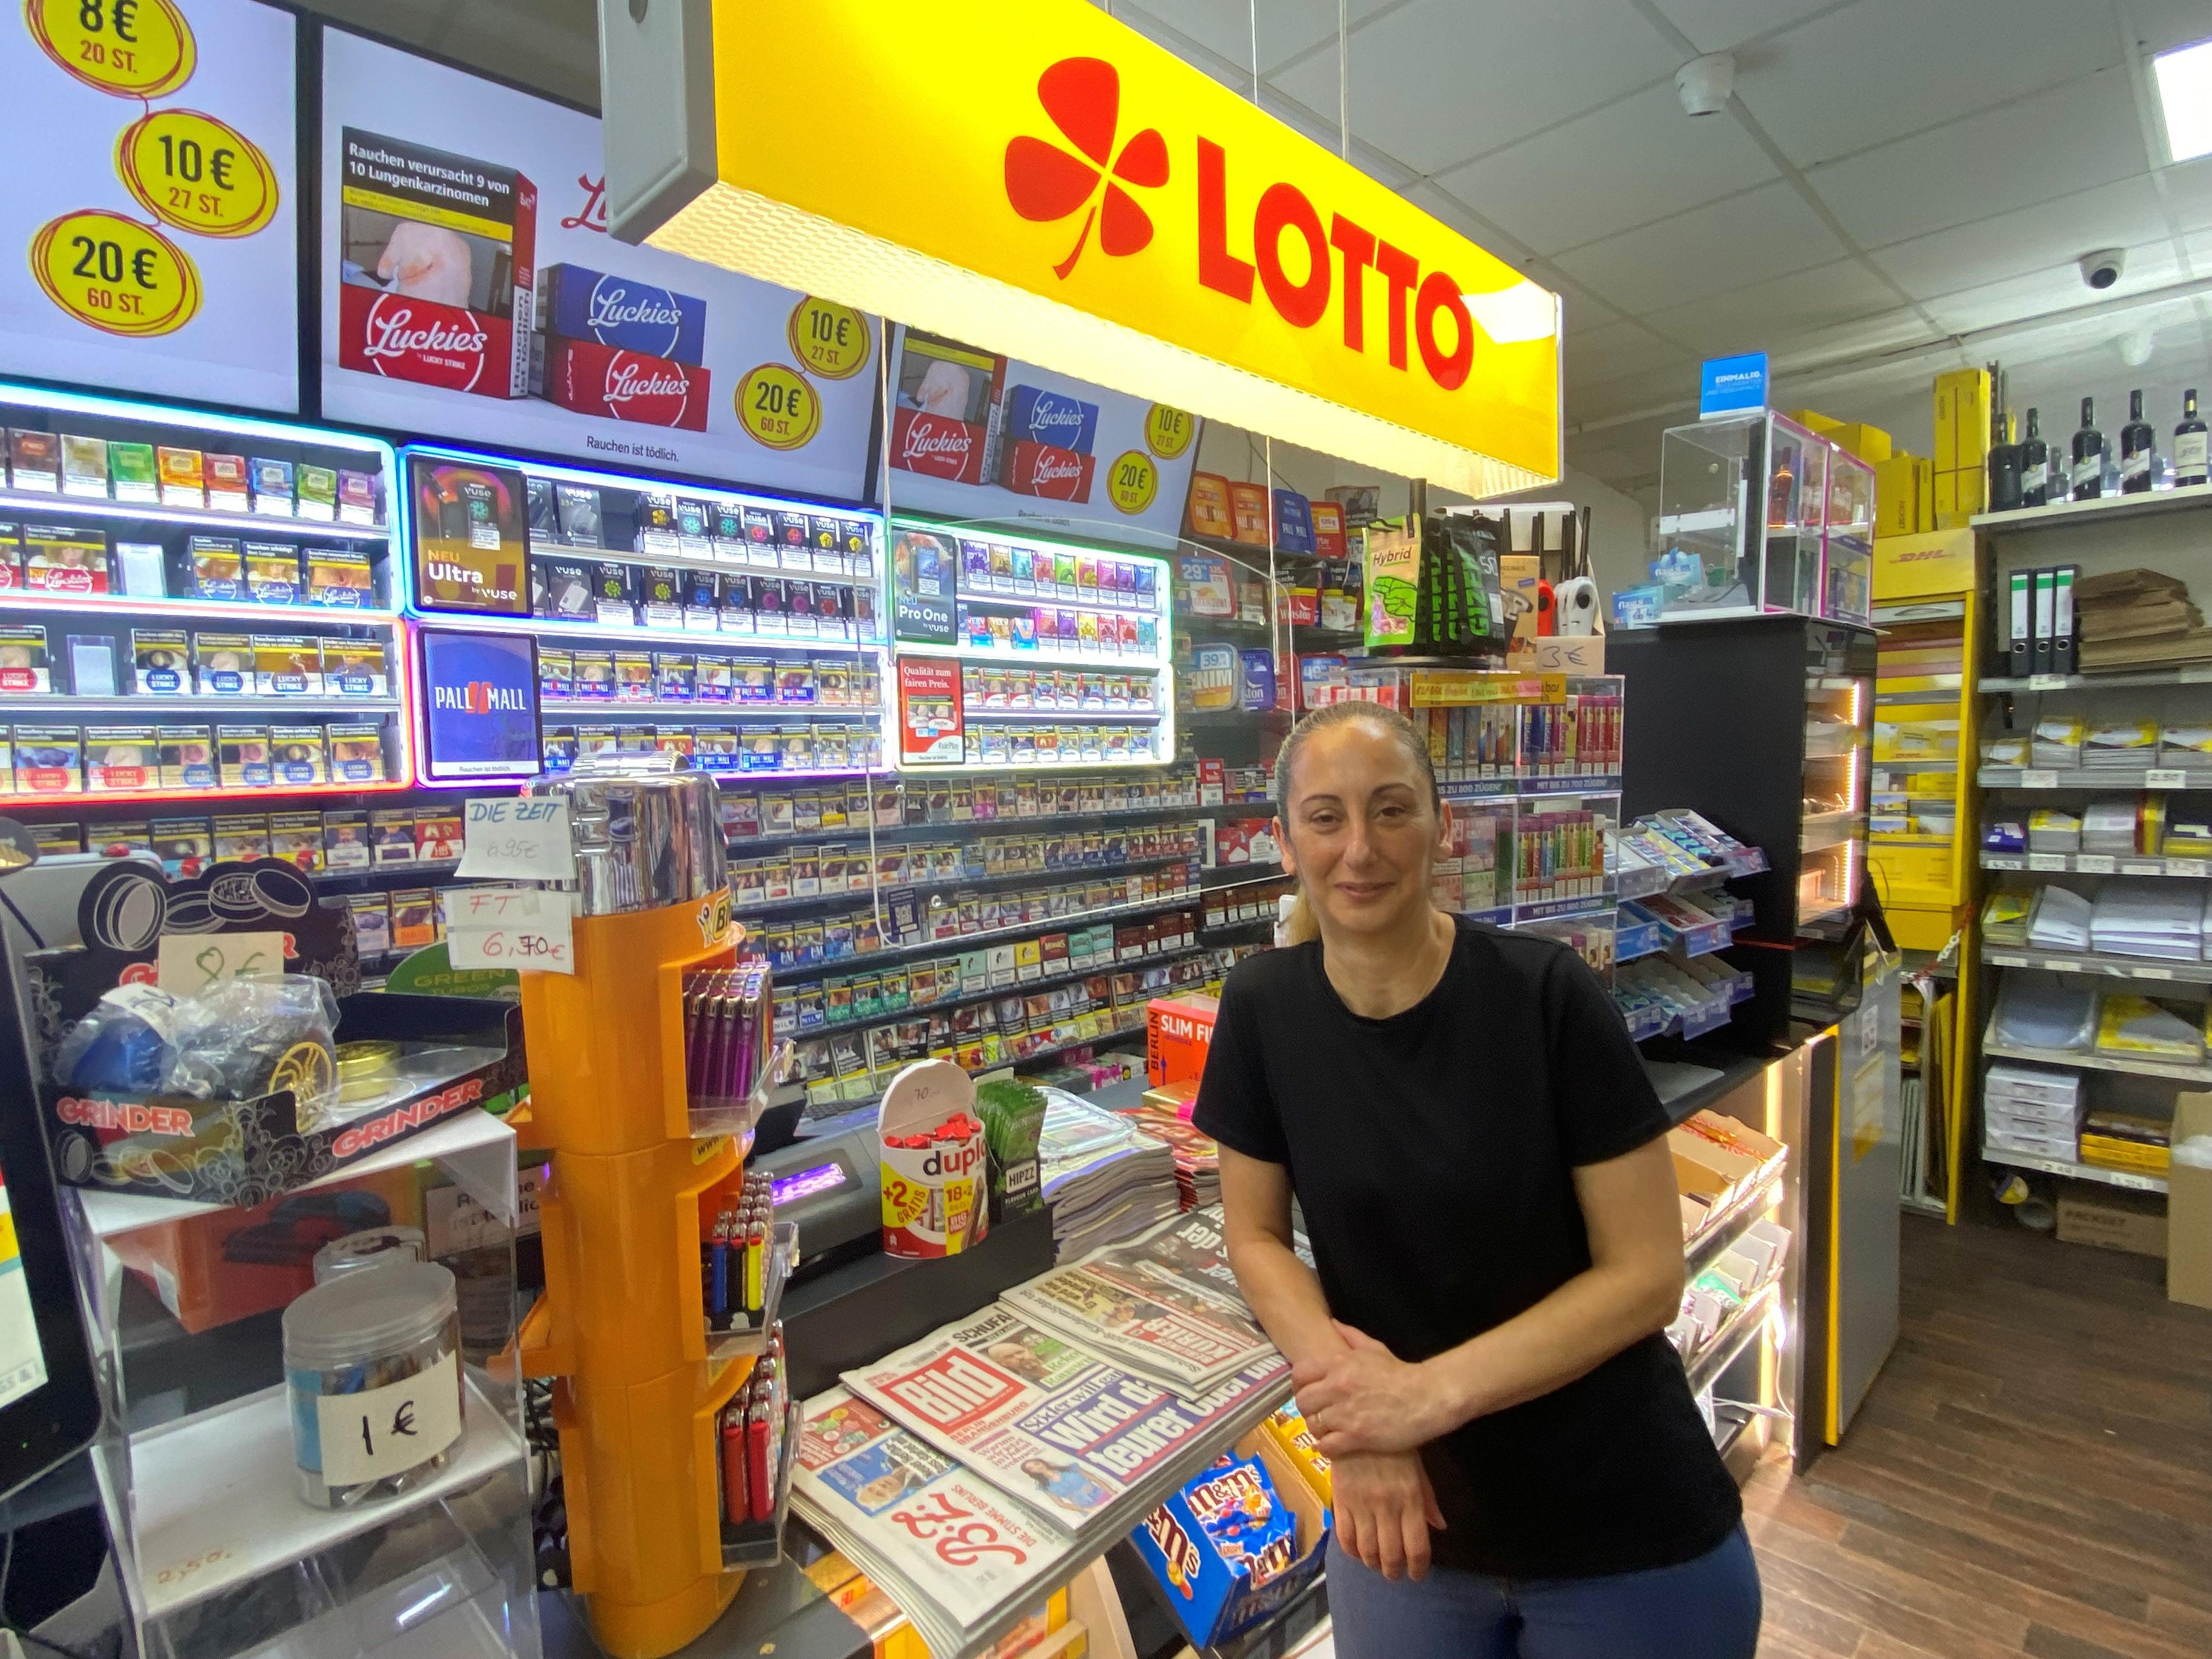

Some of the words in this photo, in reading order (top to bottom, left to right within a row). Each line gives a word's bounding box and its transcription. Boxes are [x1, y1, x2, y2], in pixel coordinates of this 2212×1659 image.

[80, 0, 103, 33] 8
[80, 40, 104, 65] 20
[112, 50, 138, 74] ST.
[159, 135, 201, 183] 10
[349, 142, 404, 168] Rauchen
[408, 159, 474, 187] verursacht
[476, 174, 484, 187] 9
[487, 182, 510, 194] von
[349, 161, 366, 177] 10
[369, 166, 489, 207] Lungenkarzinomen
[169, 187, 191, 210] 27
[199, 193, 224, 217] ST.
[72, 236, 123, 284] 20
[1198, 134, 1474, 391] LOTTO
[88, 287, 112, 309] 60
[119, 294, 144, 316] ST.
[588, 290, 681, 328] Luckies
[364, 309, 488, 358] Luckies
[811, 309, 832, 340] 10
[811, 346, 823, 361] 27
[826, 349, 840, 366] ST.
[603, 363, 690, 402] Luckies
[756, 381, 783, 412] 20
[761, 418, 774, 431] 60
[777, 419, 789, 435] ST.
[1029, 399, 1084, 428] Luckies
[587, 436, 629, 455] Rauchen
[631, 443, 644, 456] ist
[645, 445, 679, 462] tödlich.
[904, 423, 971, 458] Luckies
[1031, 455, 1083, 483] Luckies
[428, 549, 460, 563] NEU
[1374, 548, 1410, 567] Hybrid
[1899, 550, 1944, 562] DHL
[428, 563, 483, 584] Ultra
[899, 605, 921, 619] Pro
[923, 608, 948, 622] One
[904, 667, 934, 676] Qualität
[905, 678, 927, 687] fairen
[929, 679, 950, 688] Preis.
[435, 686, 473, 710] PALL
[487, 688, 526, 710] MALL
[469, 802, 505, 822] DIE
[515, 802, 562, 822] ZEIT
[434, 844, 448, 856] HB
[774, 1021, 788, 1029] NIL
[1161, 1014, 1193, 1039] SLIM
[1150, 1011, 1159, 1070] BERLIN
[57, 1098, 195, 1137] GRINDER
[332, 1078, 483, 1158] GRINDER
[1009, 1167, 1035, 1187] HIPZZ
[897, 1189, 926, 1223] GRATIS
[1143, 1317, 1238, 1358] KURIER
[362, 1416, 373, 1455] 1
[392, 1401, 417, 1437] €
[950, 1419, 985, 1440] BERLIN
[1040, 1393, 1138, 1455] Wird
[1089, 1407, 1195, 1477] teurer
[1019, 1527, 1037, 1547] DIE
